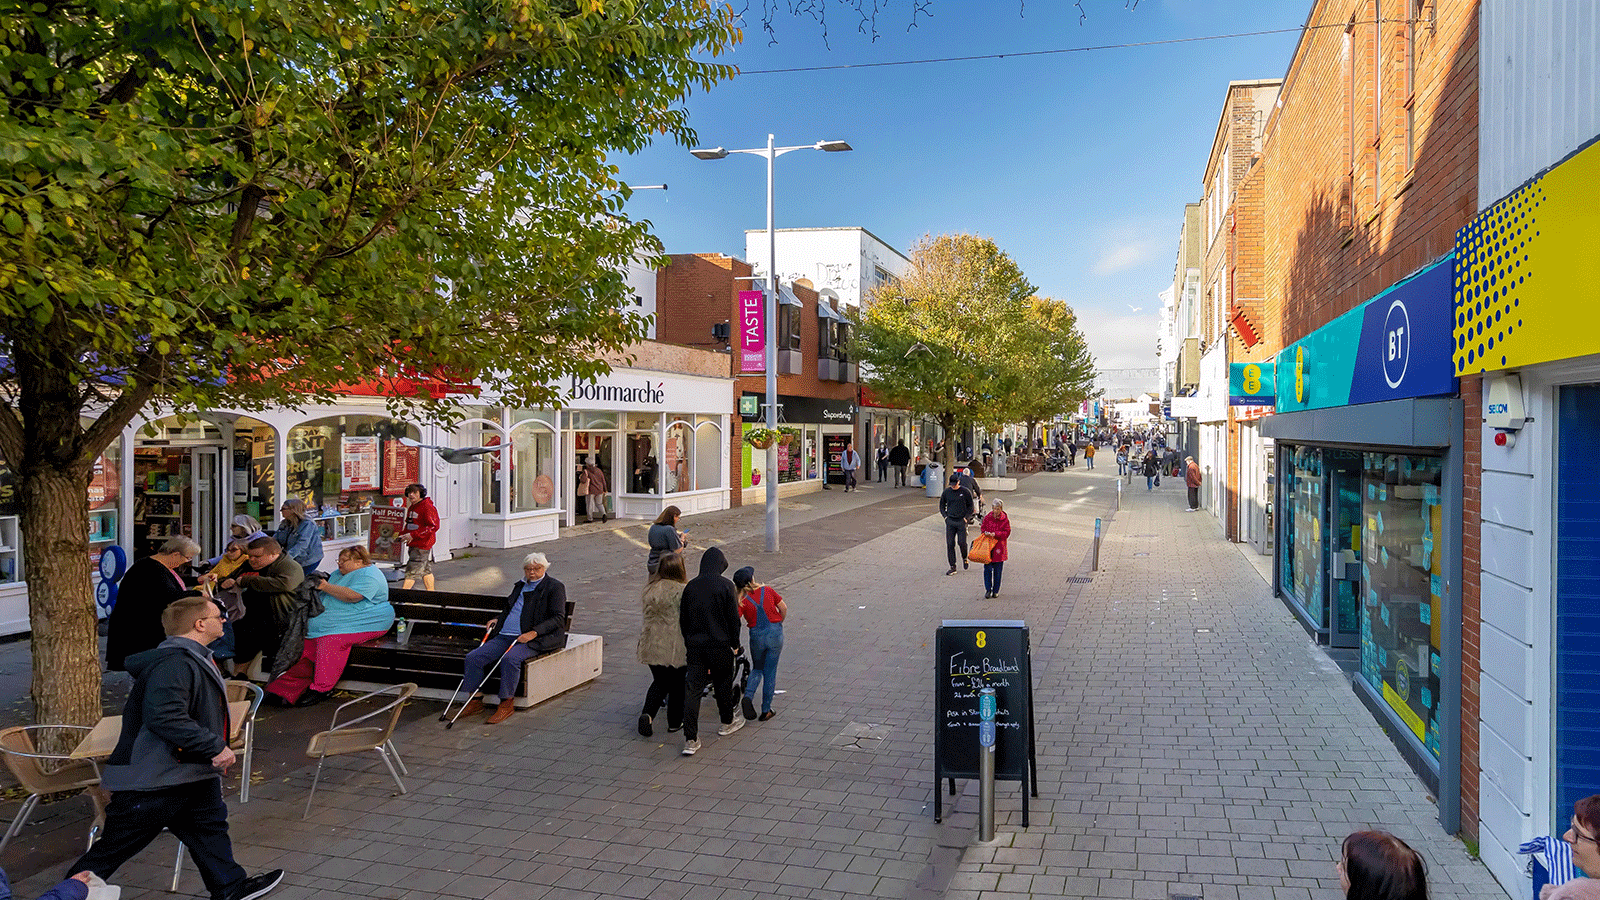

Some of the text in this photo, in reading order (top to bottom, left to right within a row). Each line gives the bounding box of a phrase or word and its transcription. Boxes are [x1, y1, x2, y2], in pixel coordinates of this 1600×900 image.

[744, 298, 759, 346] TASTE
[1388, 326, 1404, 361] BT
[571, 374, 665, 404] Bonmarché
[1488, 403, 1508, 414] SECOM
[303, 479, 312, 488] &
[371, 508, 386, 517] Half
[387, 510, 405, 518] Price
[949, 651, 981, 674] Fibre
[992, 678, 1010, 687] month
